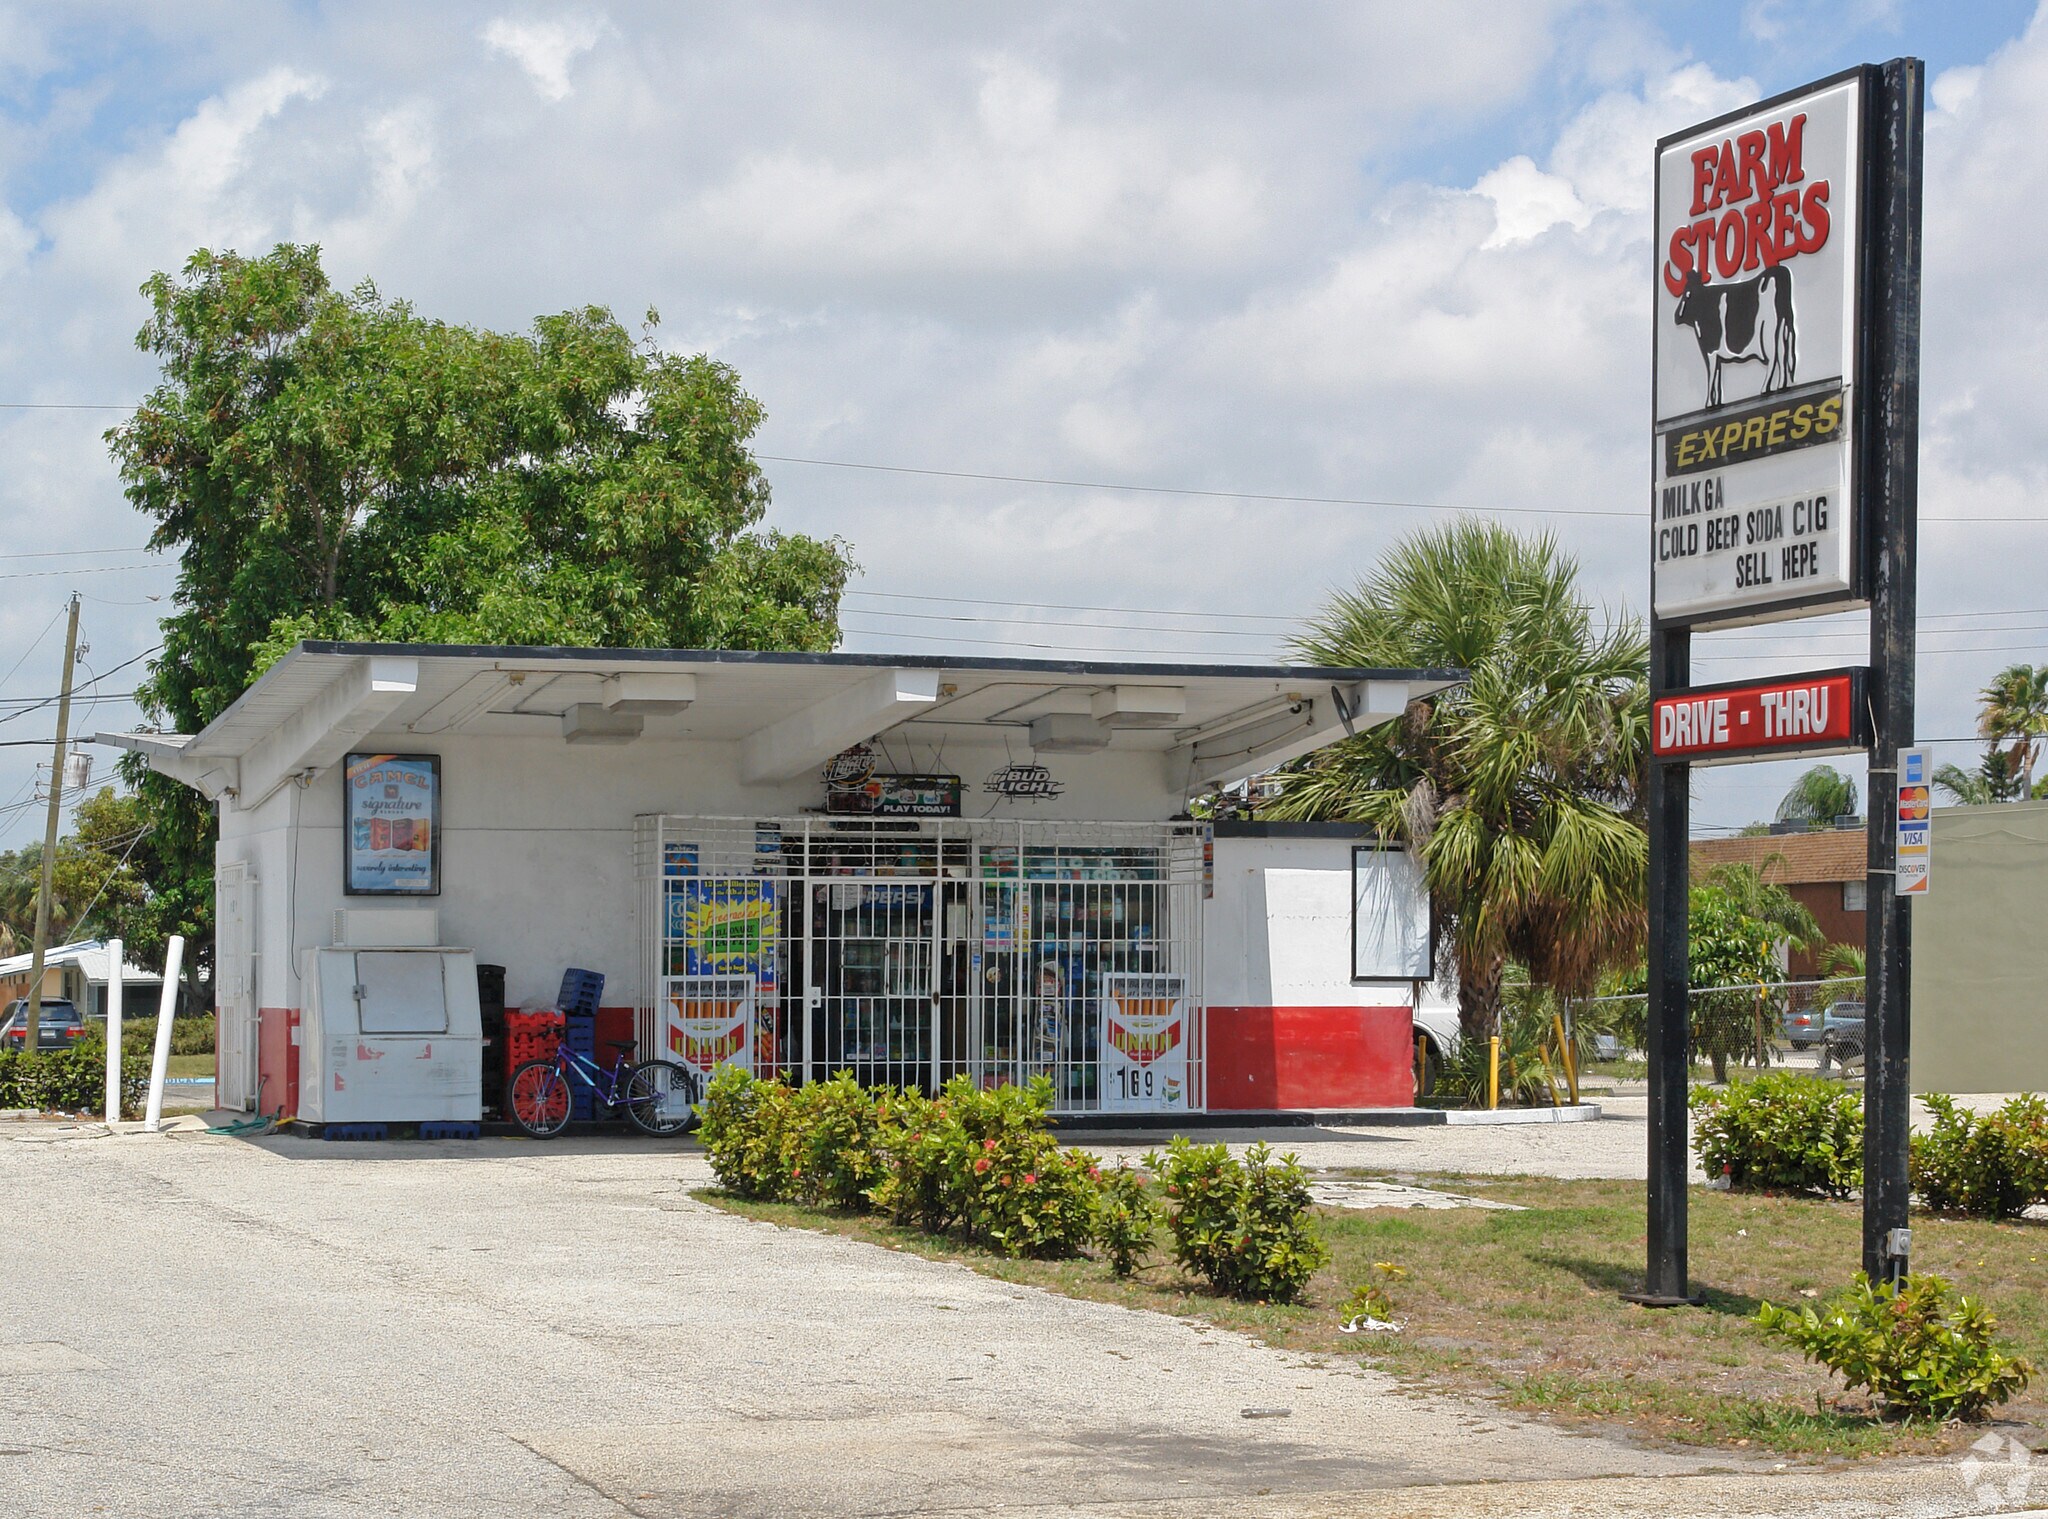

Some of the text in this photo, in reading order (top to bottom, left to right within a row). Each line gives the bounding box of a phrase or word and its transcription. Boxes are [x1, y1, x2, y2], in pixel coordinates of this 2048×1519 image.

[1689, 113, 1807, 217] FARM
[1663, 179, 1830, 298] STORES
[1675, 399, 1842, 468] EXPRESS
[1662, 475, 1724, 521] MILK GA
[1659, 523, 1698, 562] COLD
[1746, 505, 1783, 545] SODA
[1793, 496, 1828, 537] CIG
[1736, 552, 1772, 589] SELL
[1659, 686, 1829, 749] DRIVE THRU
[354, 770, 430, 790] CAMEL
[1006, 771, 1050, 782] BUD
[997, 782, 1057, 793] LIGHT
[361, 797, 422, 816] signature
[883, 804, 951, 814] PLAY TODAY!
[1903, 832, 1923, 846] VISA
[1898, 863, 1926, 874] DISCOVER
[866, 890, 926, 905] PEPSI
[675, 1036, 737, 1057] UNION
[1115, 1033, 1173, 1052] UNION
